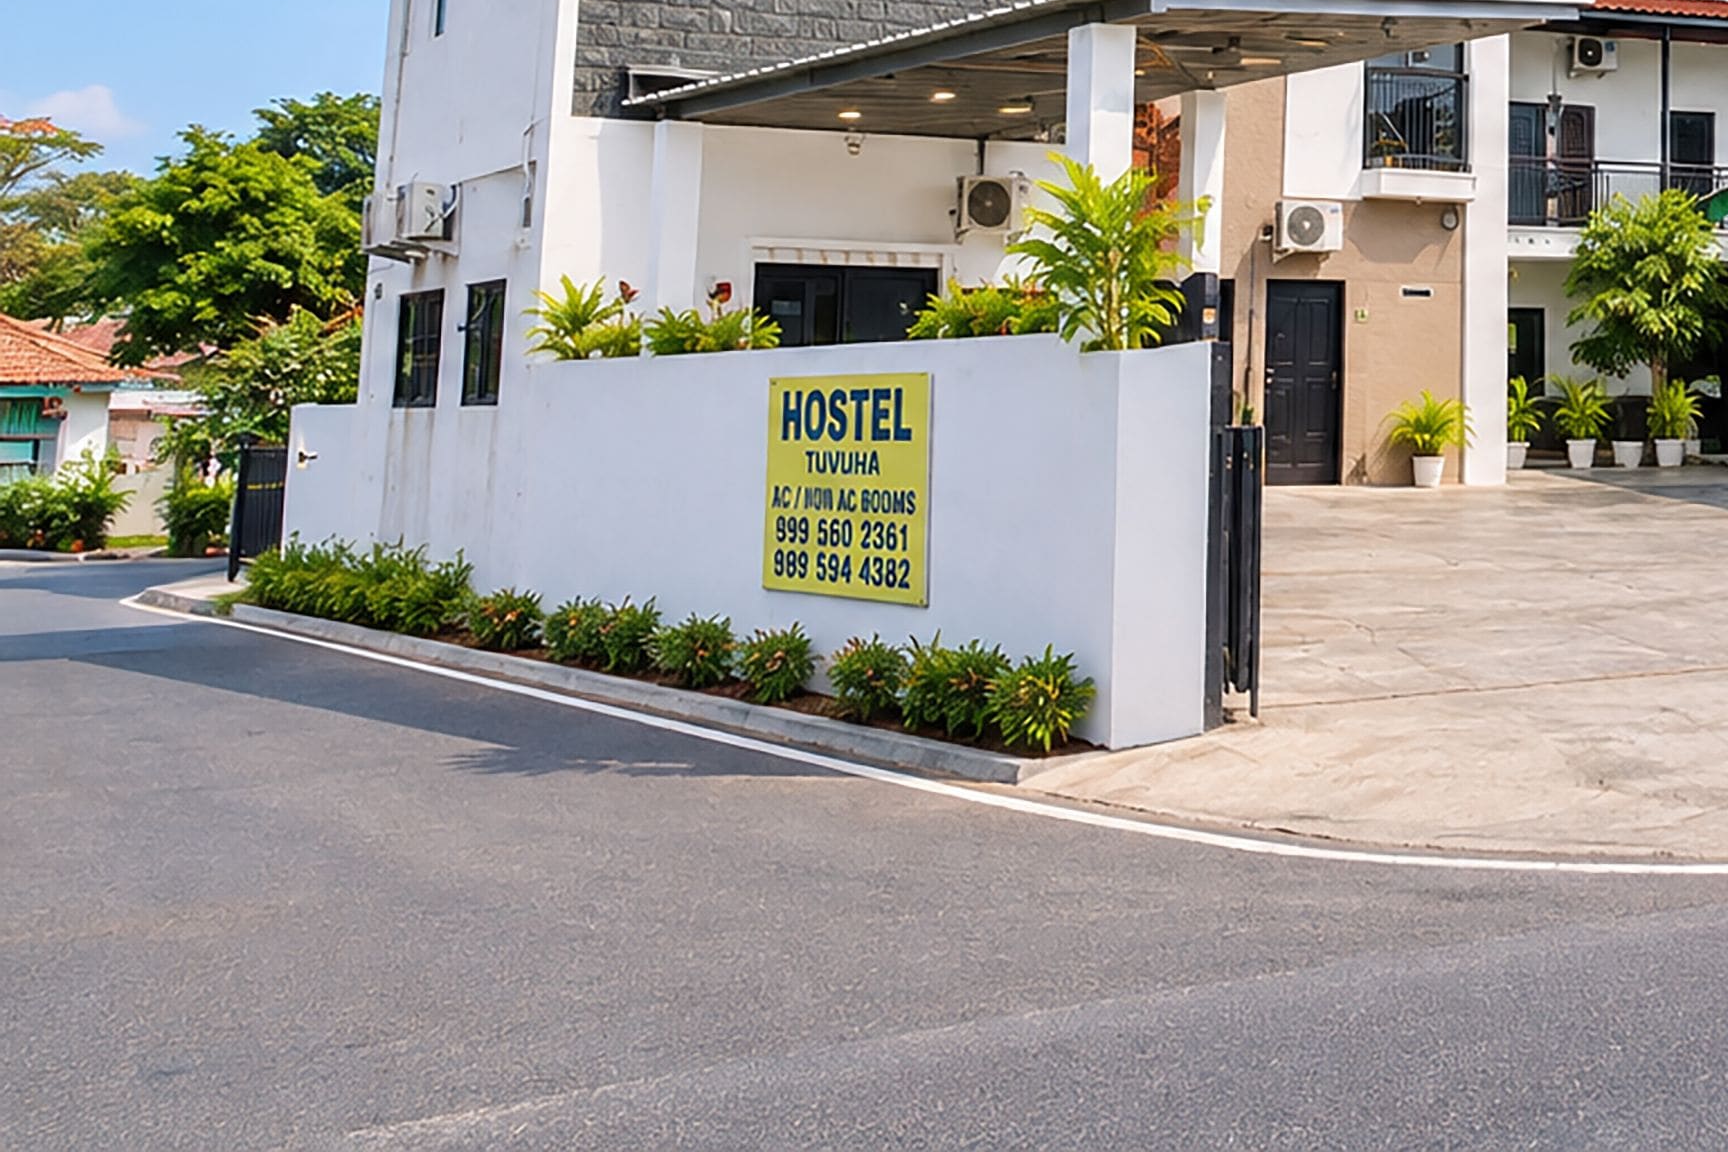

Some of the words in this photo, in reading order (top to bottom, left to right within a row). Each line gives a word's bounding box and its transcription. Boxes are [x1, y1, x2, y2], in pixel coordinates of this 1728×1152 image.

[782, 388, 912, 441] HOSTEL
[806, 450, 880, 475] TUVUHA
[772, 485, 792, 508] AC
[837, 488, 857, 512] AC
[860, 520, 908, 552] 2361
[774, 548, 808, 579] 989
[816, 551, 852, 584] 594
[858, 555, 910, 589] 4382
